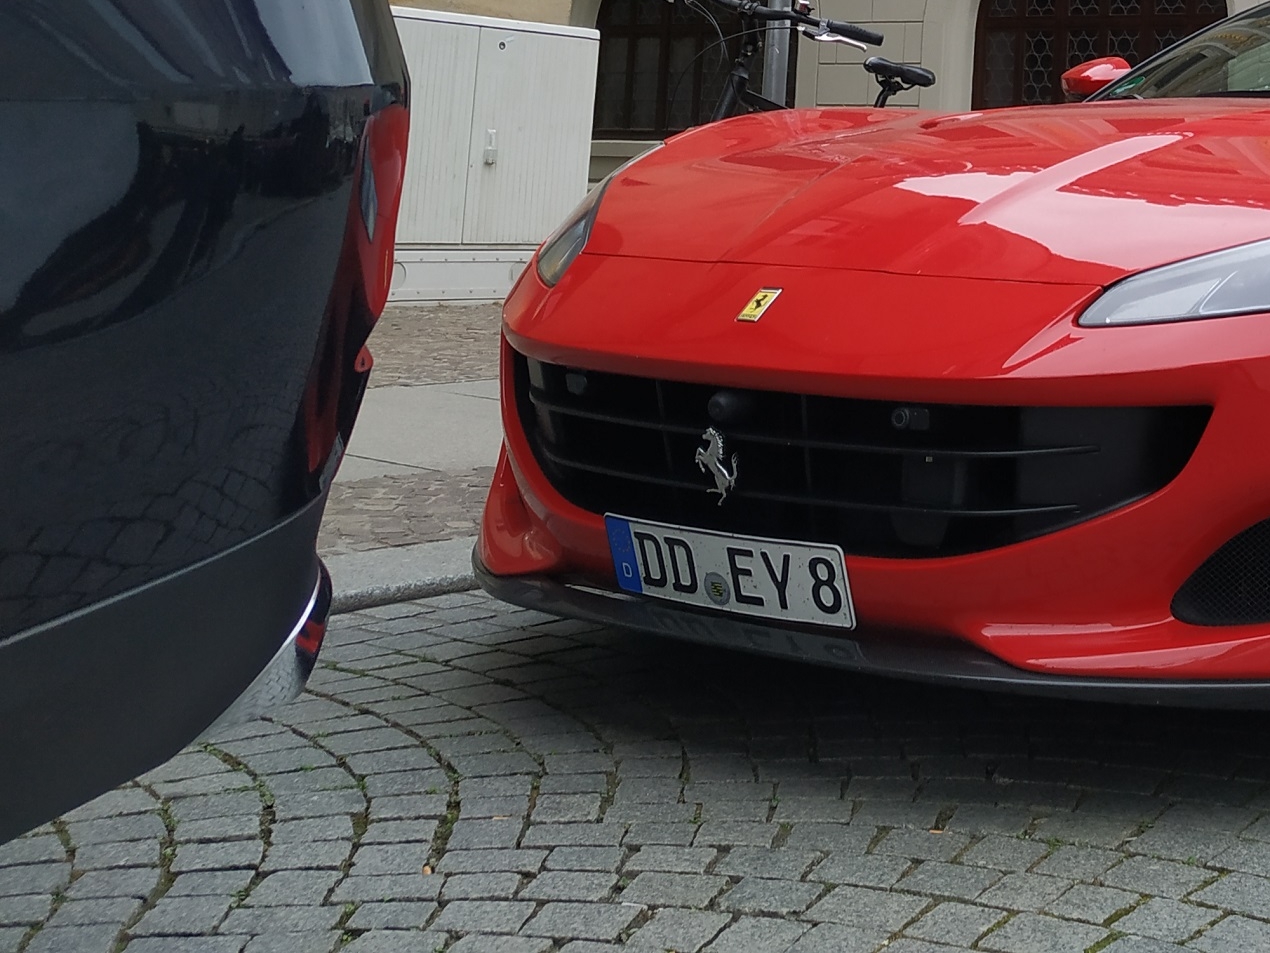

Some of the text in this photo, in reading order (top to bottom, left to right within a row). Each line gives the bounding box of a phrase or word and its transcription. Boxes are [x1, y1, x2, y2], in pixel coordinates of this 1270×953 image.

[622, 562, 633, 578] D
[633, 530, 842, 615] DD EY 8
